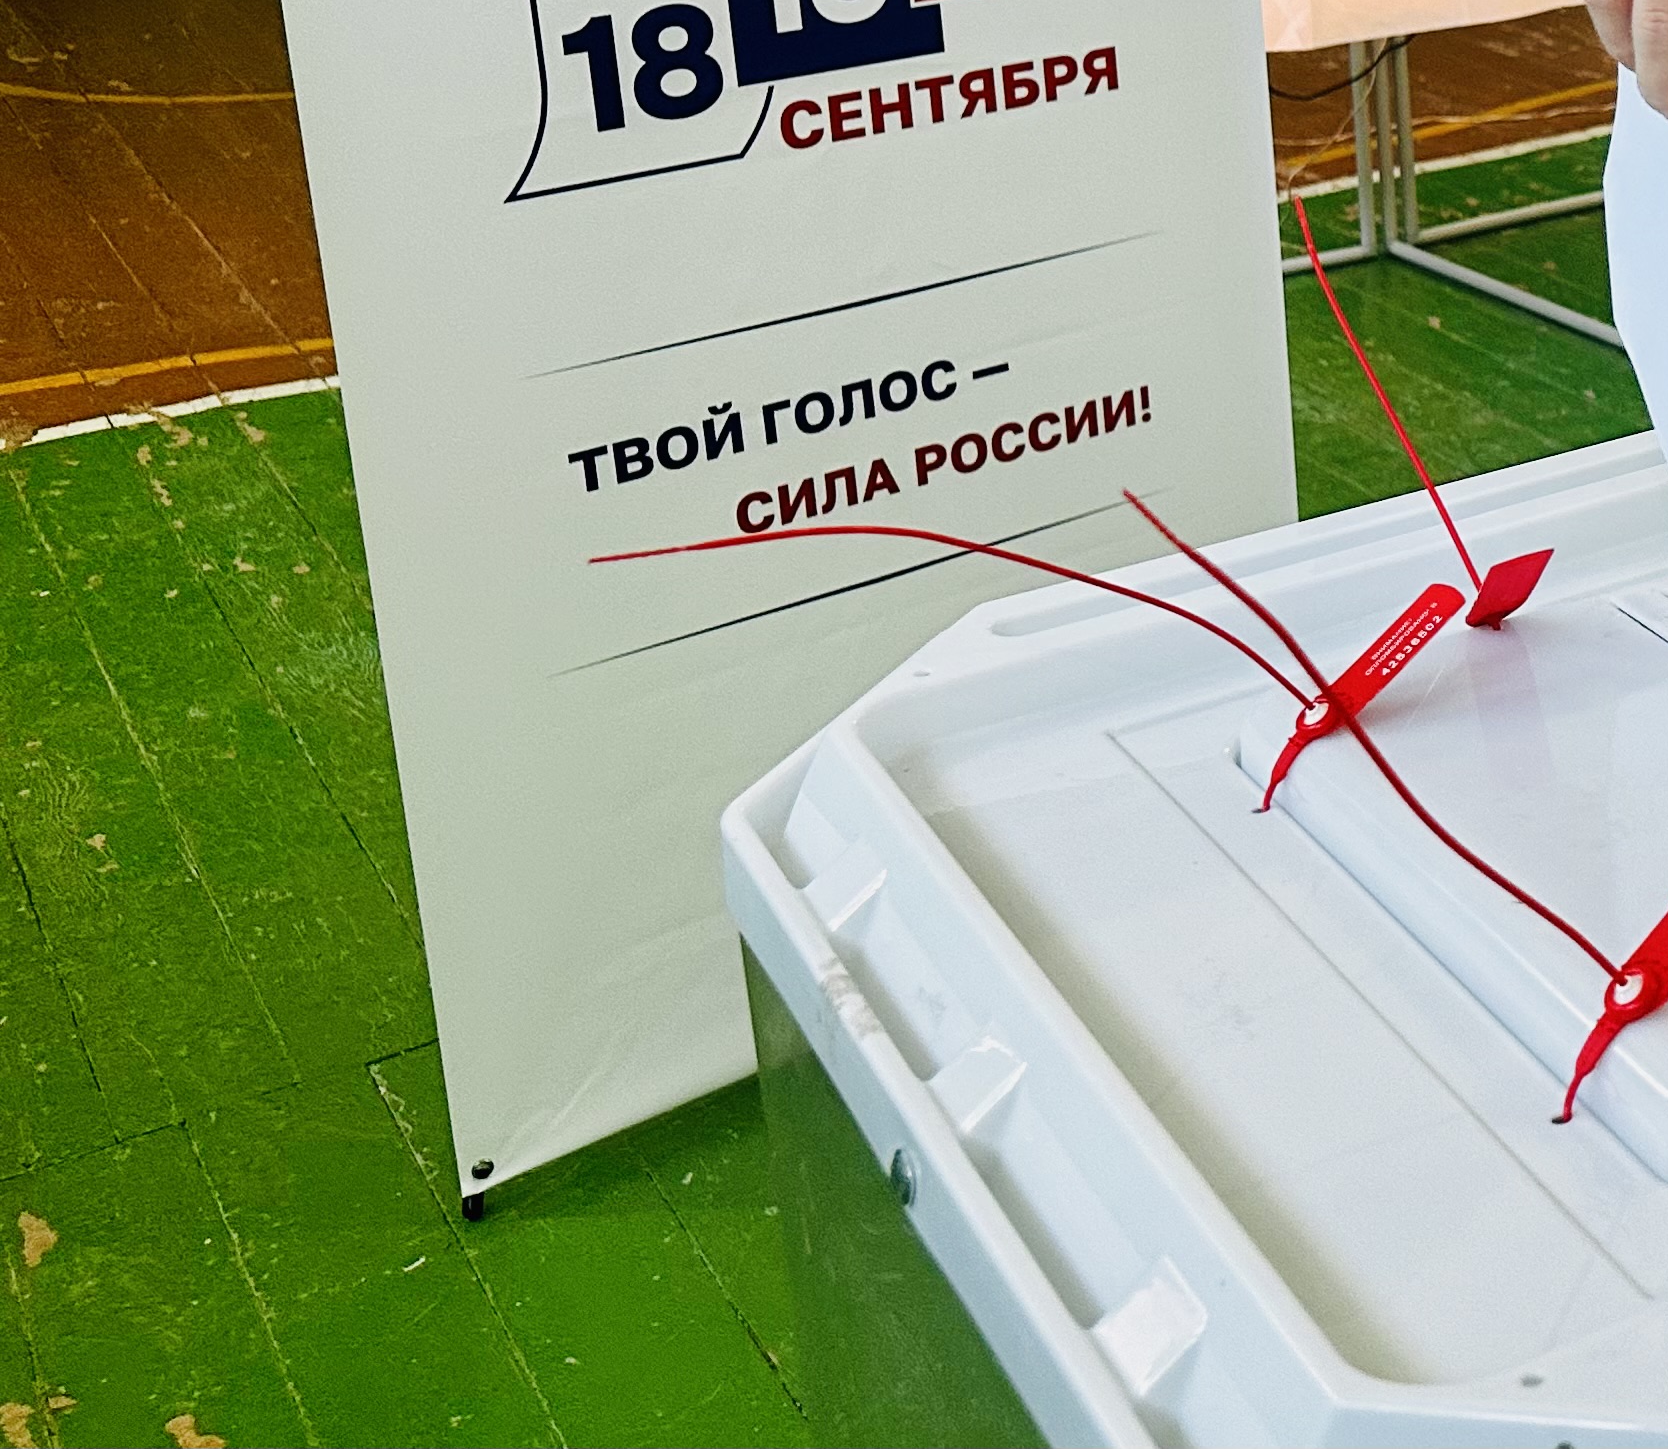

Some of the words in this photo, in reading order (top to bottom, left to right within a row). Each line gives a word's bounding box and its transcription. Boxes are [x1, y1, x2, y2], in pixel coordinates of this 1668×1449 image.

[561, 2, 724, 132] 18
[780, 45, 1120, 150] СЕНТЯБРЯ
[567, 402, 745, 493] ТВОЙ
[761, 359, 958, 446] ГОЛОС
[736, 457, 900, 534] СИЛА
[914, 385, 1153, 487] РОССИИ!
